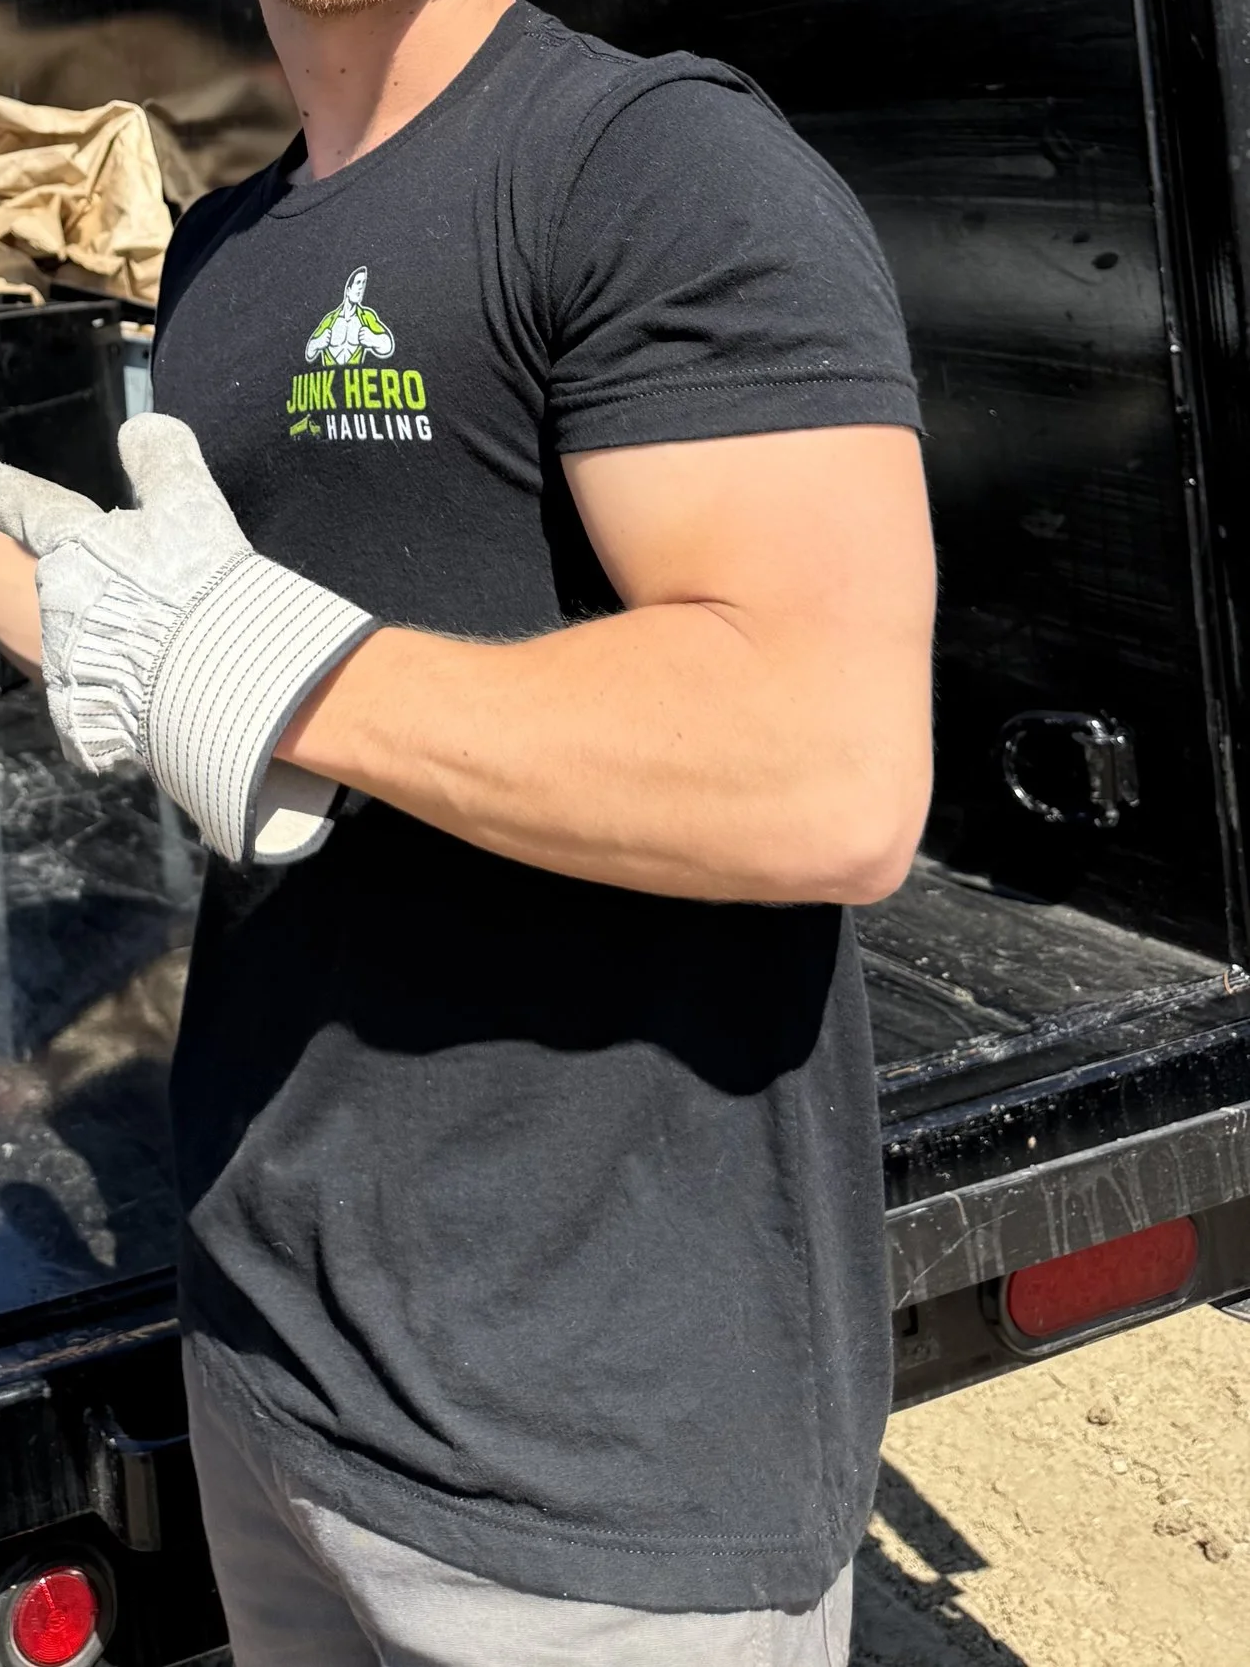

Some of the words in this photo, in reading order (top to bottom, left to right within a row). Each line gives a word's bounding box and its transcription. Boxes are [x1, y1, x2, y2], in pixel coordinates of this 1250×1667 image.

[286, 370, 337, 414] JUNK
[344, 368, 426, 410] HERO
[326, 414, 432, 441] HAULING
